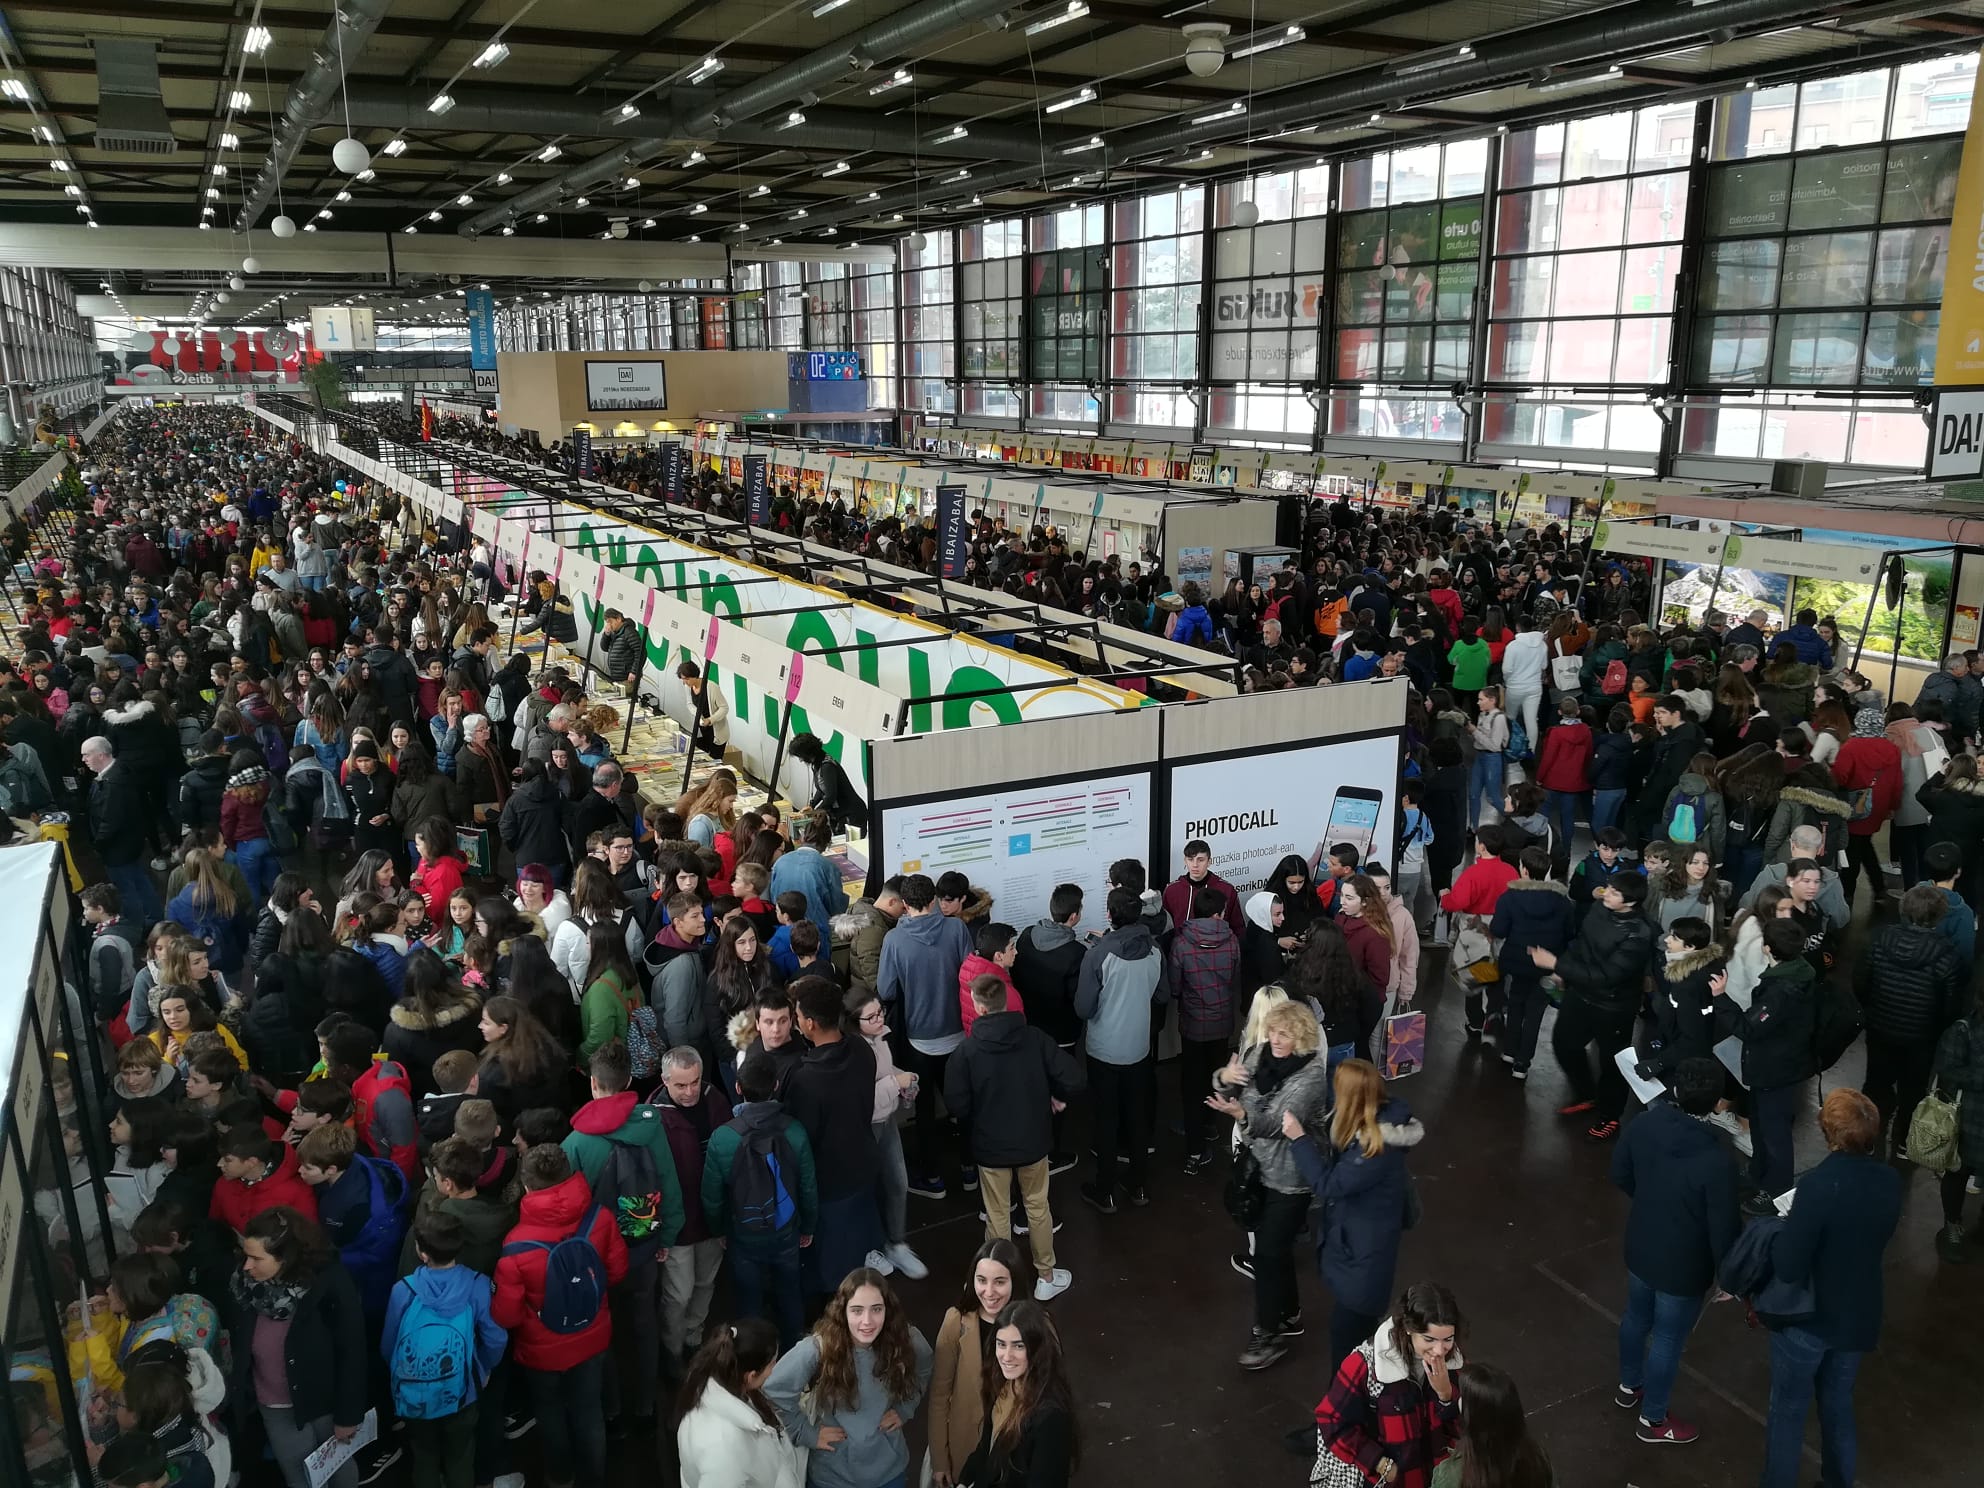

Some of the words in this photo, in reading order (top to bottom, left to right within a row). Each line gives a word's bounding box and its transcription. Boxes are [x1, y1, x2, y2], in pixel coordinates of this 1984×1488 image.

[480, 331, 489, 356] ARETO
[811, 354, 826, 378] 02
[188, 373, 214, 385] eitb
[477, 375, 495, 387] DA!
[1939, 413, 1983, 456] DA!
[668, 445, 679, 491] IBAIZABAL
[752, 458, 766, 512] IBAIZABAL
[944, 490, 965, 561] IBAIZABAL
[791, 672, 801, 689] 112
[832, 695, 845, 710] EREIN
[1185, 809, 1279, 840] PHOTOCALL
